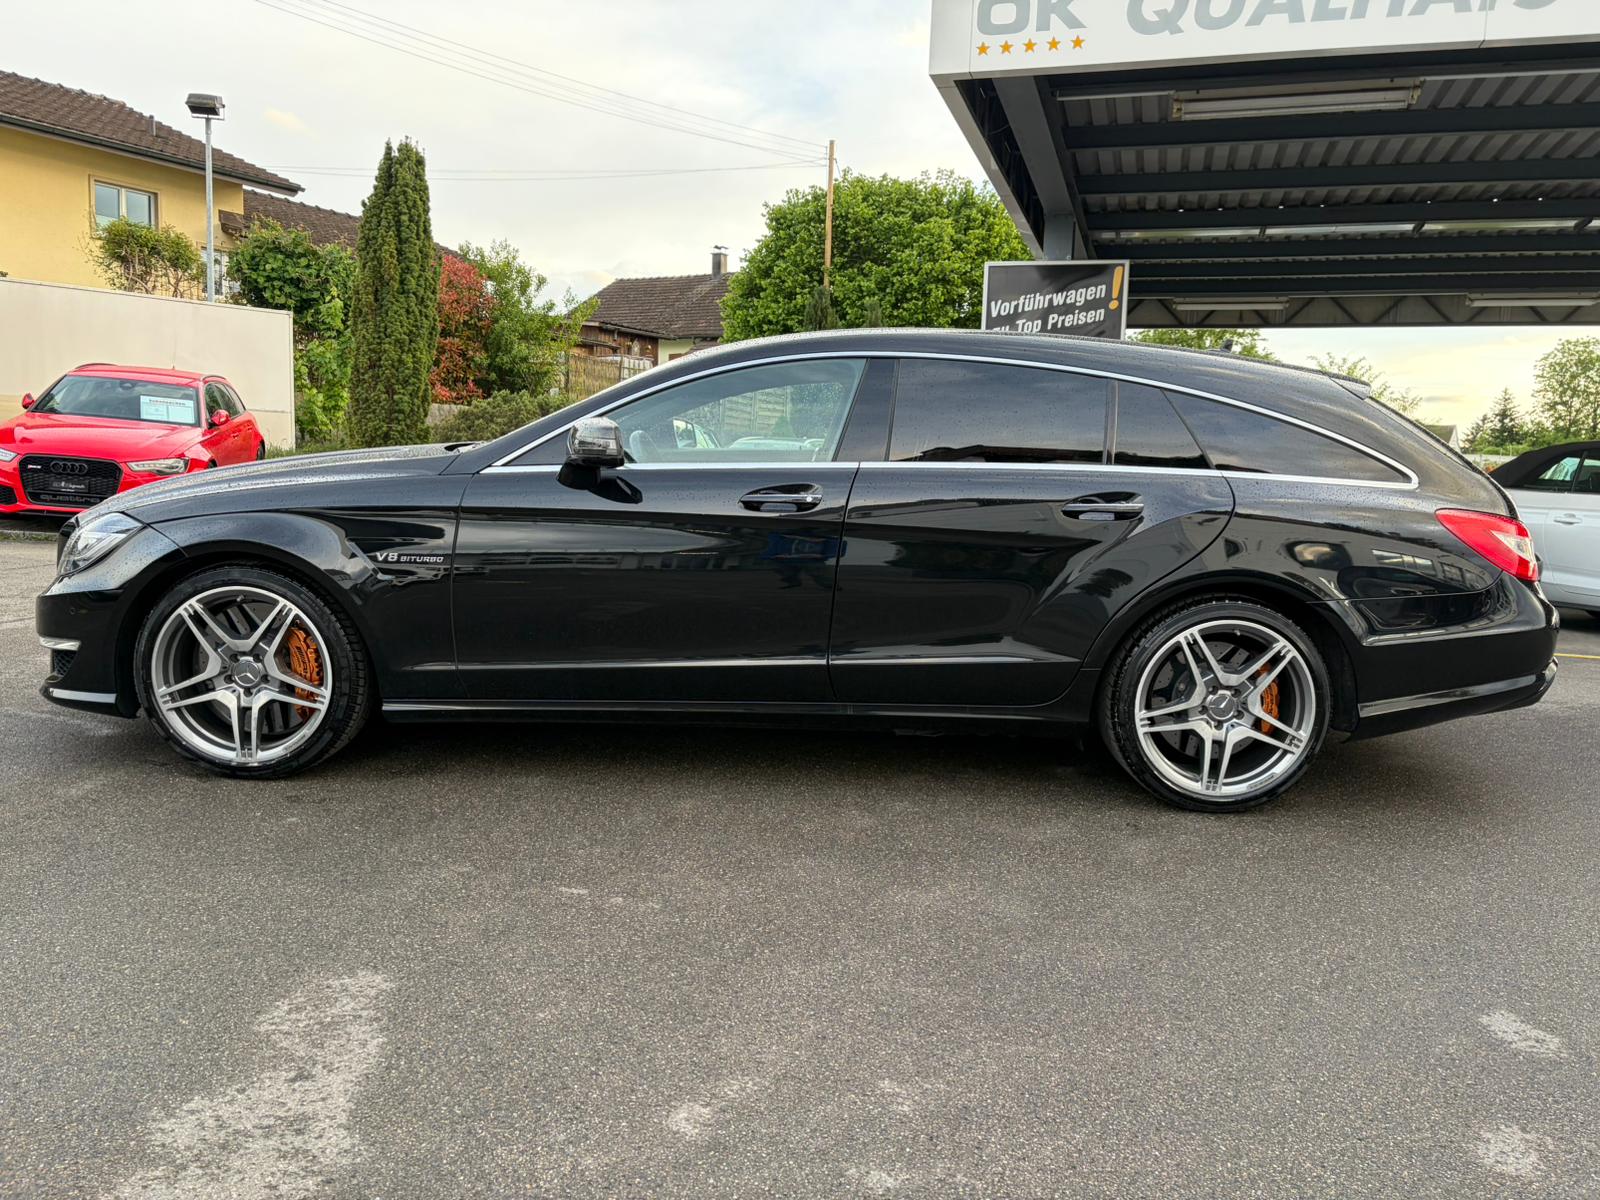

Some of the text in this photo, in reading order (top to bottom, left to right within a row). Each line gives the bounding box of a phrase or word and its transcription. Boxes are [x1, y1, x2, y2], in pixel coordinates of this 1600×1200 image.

[990, 284, 1107, 318] Vorführwagen
[1015, 308, 1106, 333] Top Preisen
[376, 552, 444, 563] V8 BITURBO
